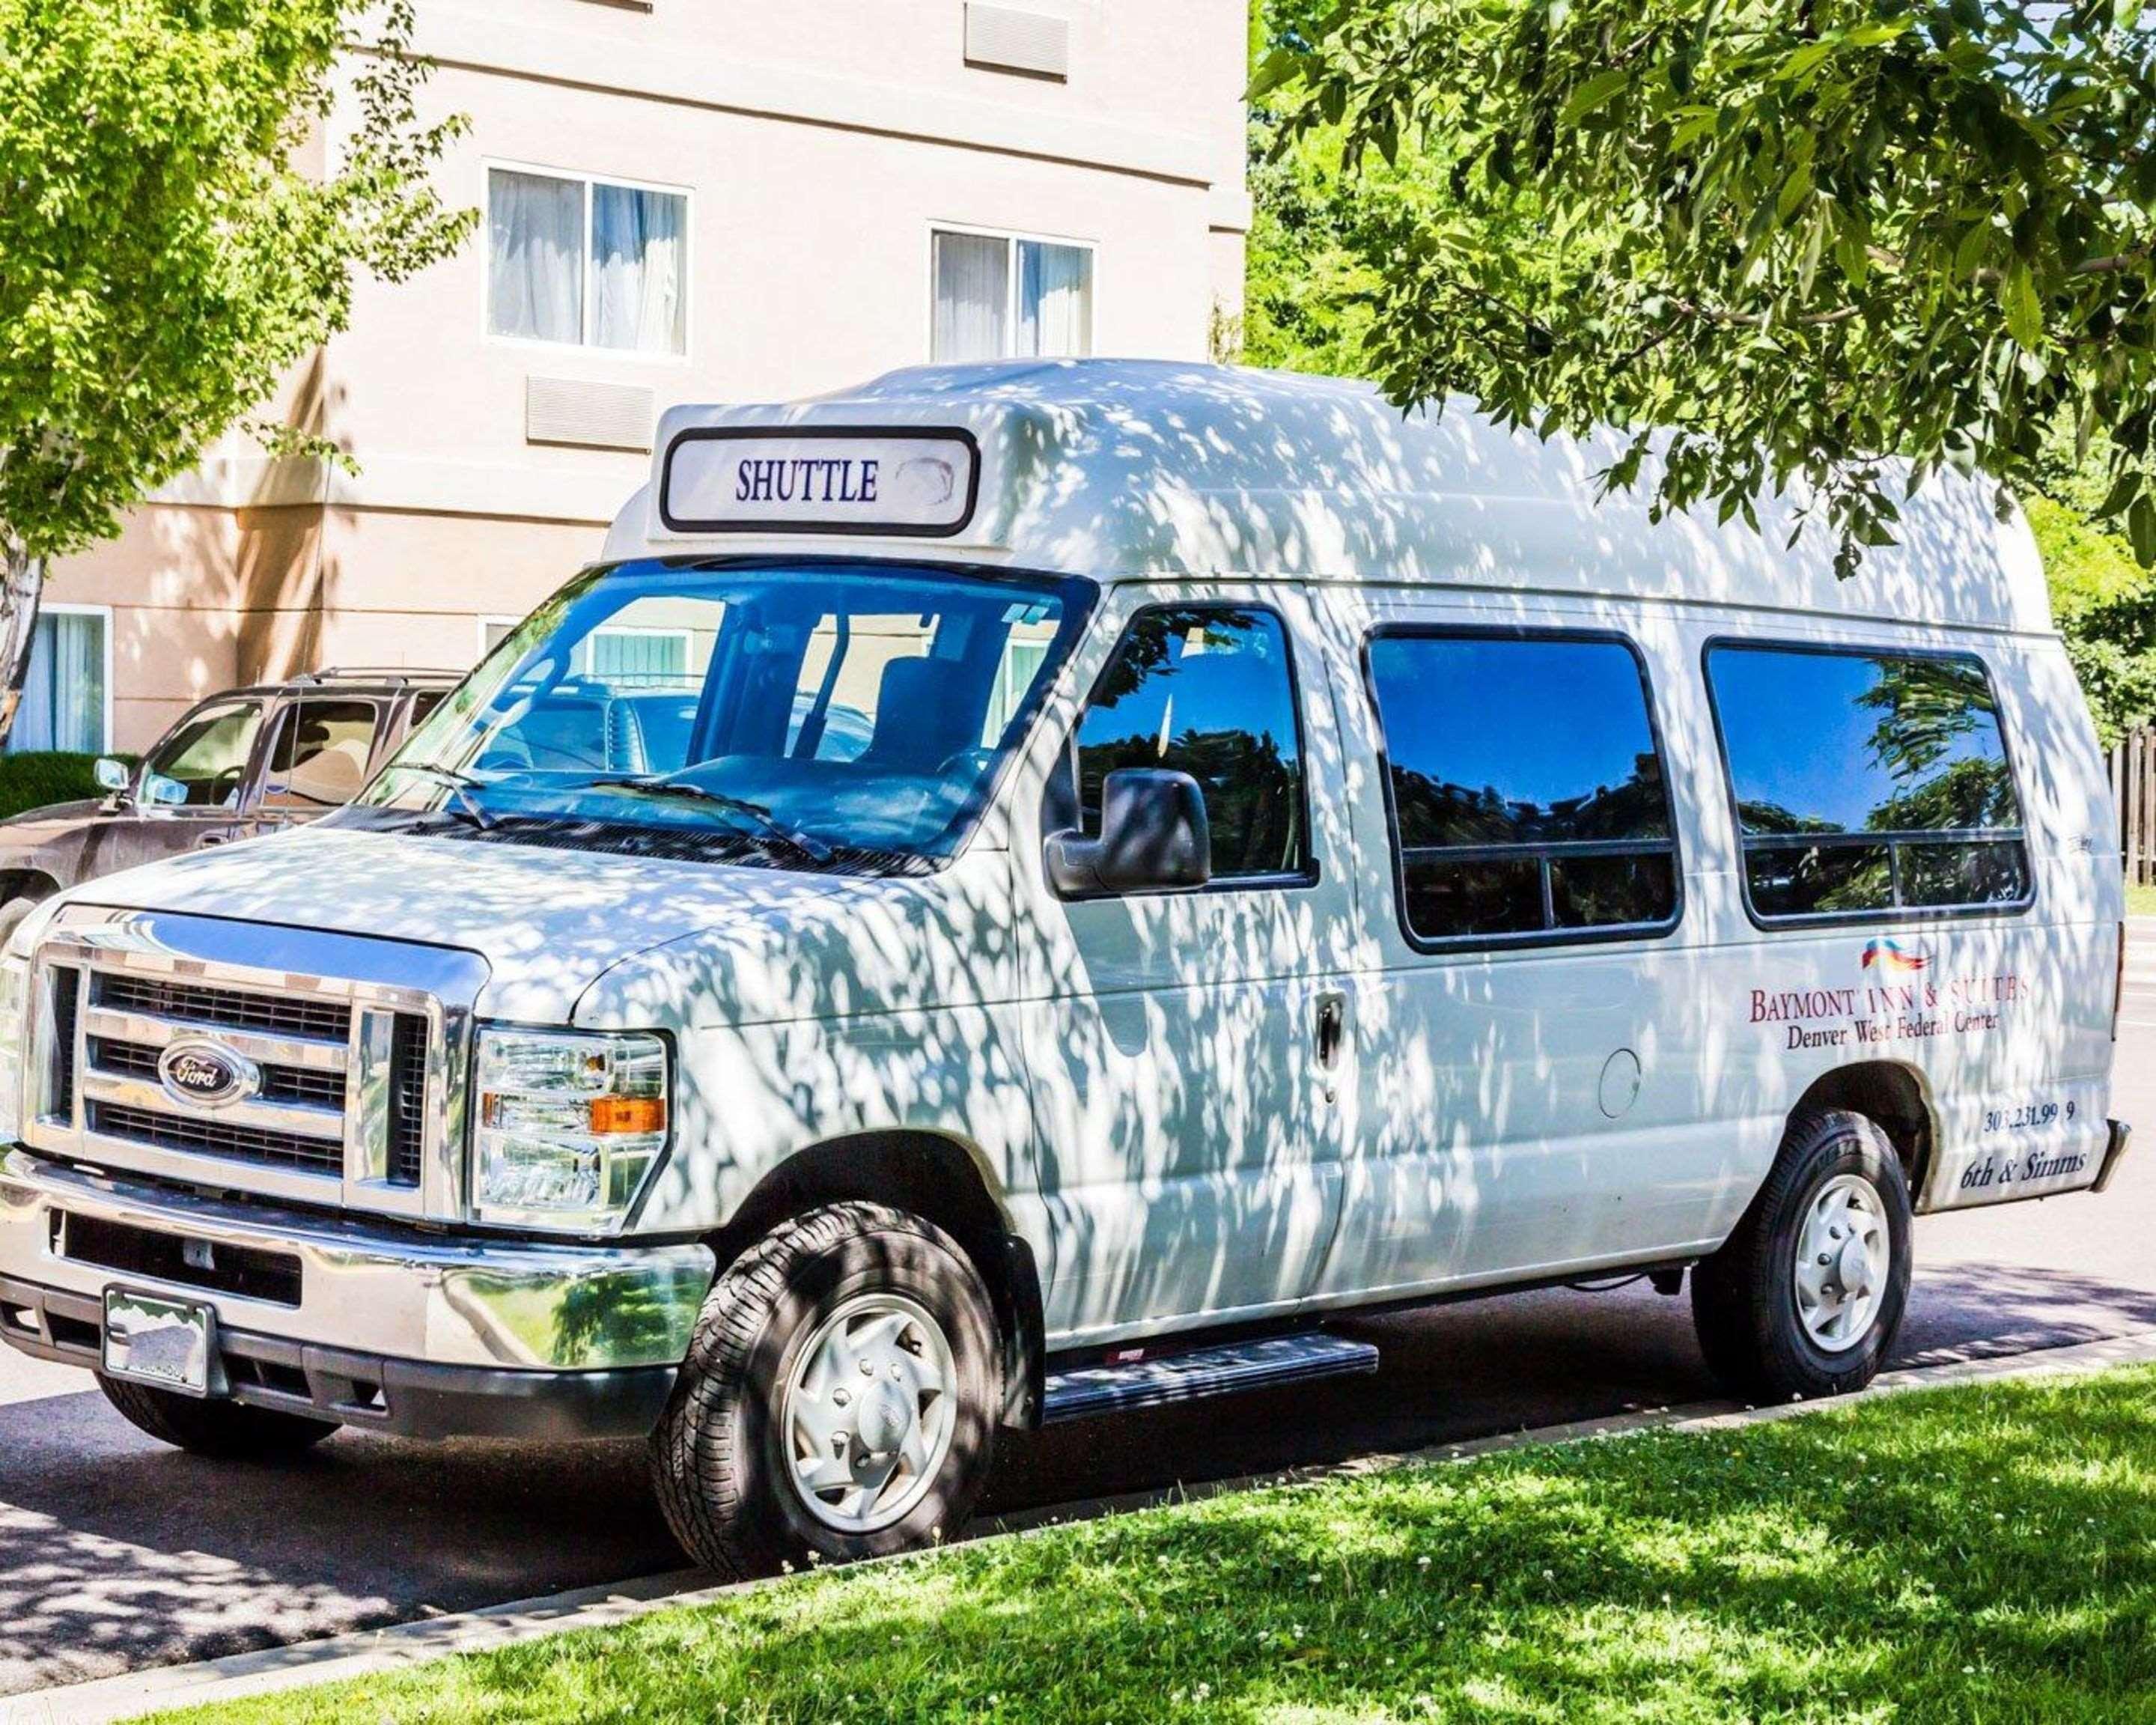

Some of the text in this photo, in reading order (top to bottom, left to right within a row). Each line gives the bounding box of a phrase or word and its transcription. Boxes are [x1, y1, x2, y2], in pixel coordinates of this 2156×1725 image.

[735, 458, 879, 502] SHUTTLE
[1750, 989, 1855, 1023] BAYMONT
[1868, 985, 1913, 1013] INN
[1925, 982, 1937, 1008] &
[1787, 1011, 2000, 1050] Denver West Federal Center
[176, 1055, 217, 1087] Ford
[1984, 1101, 2075, 1133] 303.231.999
[1960, 1151, 2087, 1189] 6th & Simms
